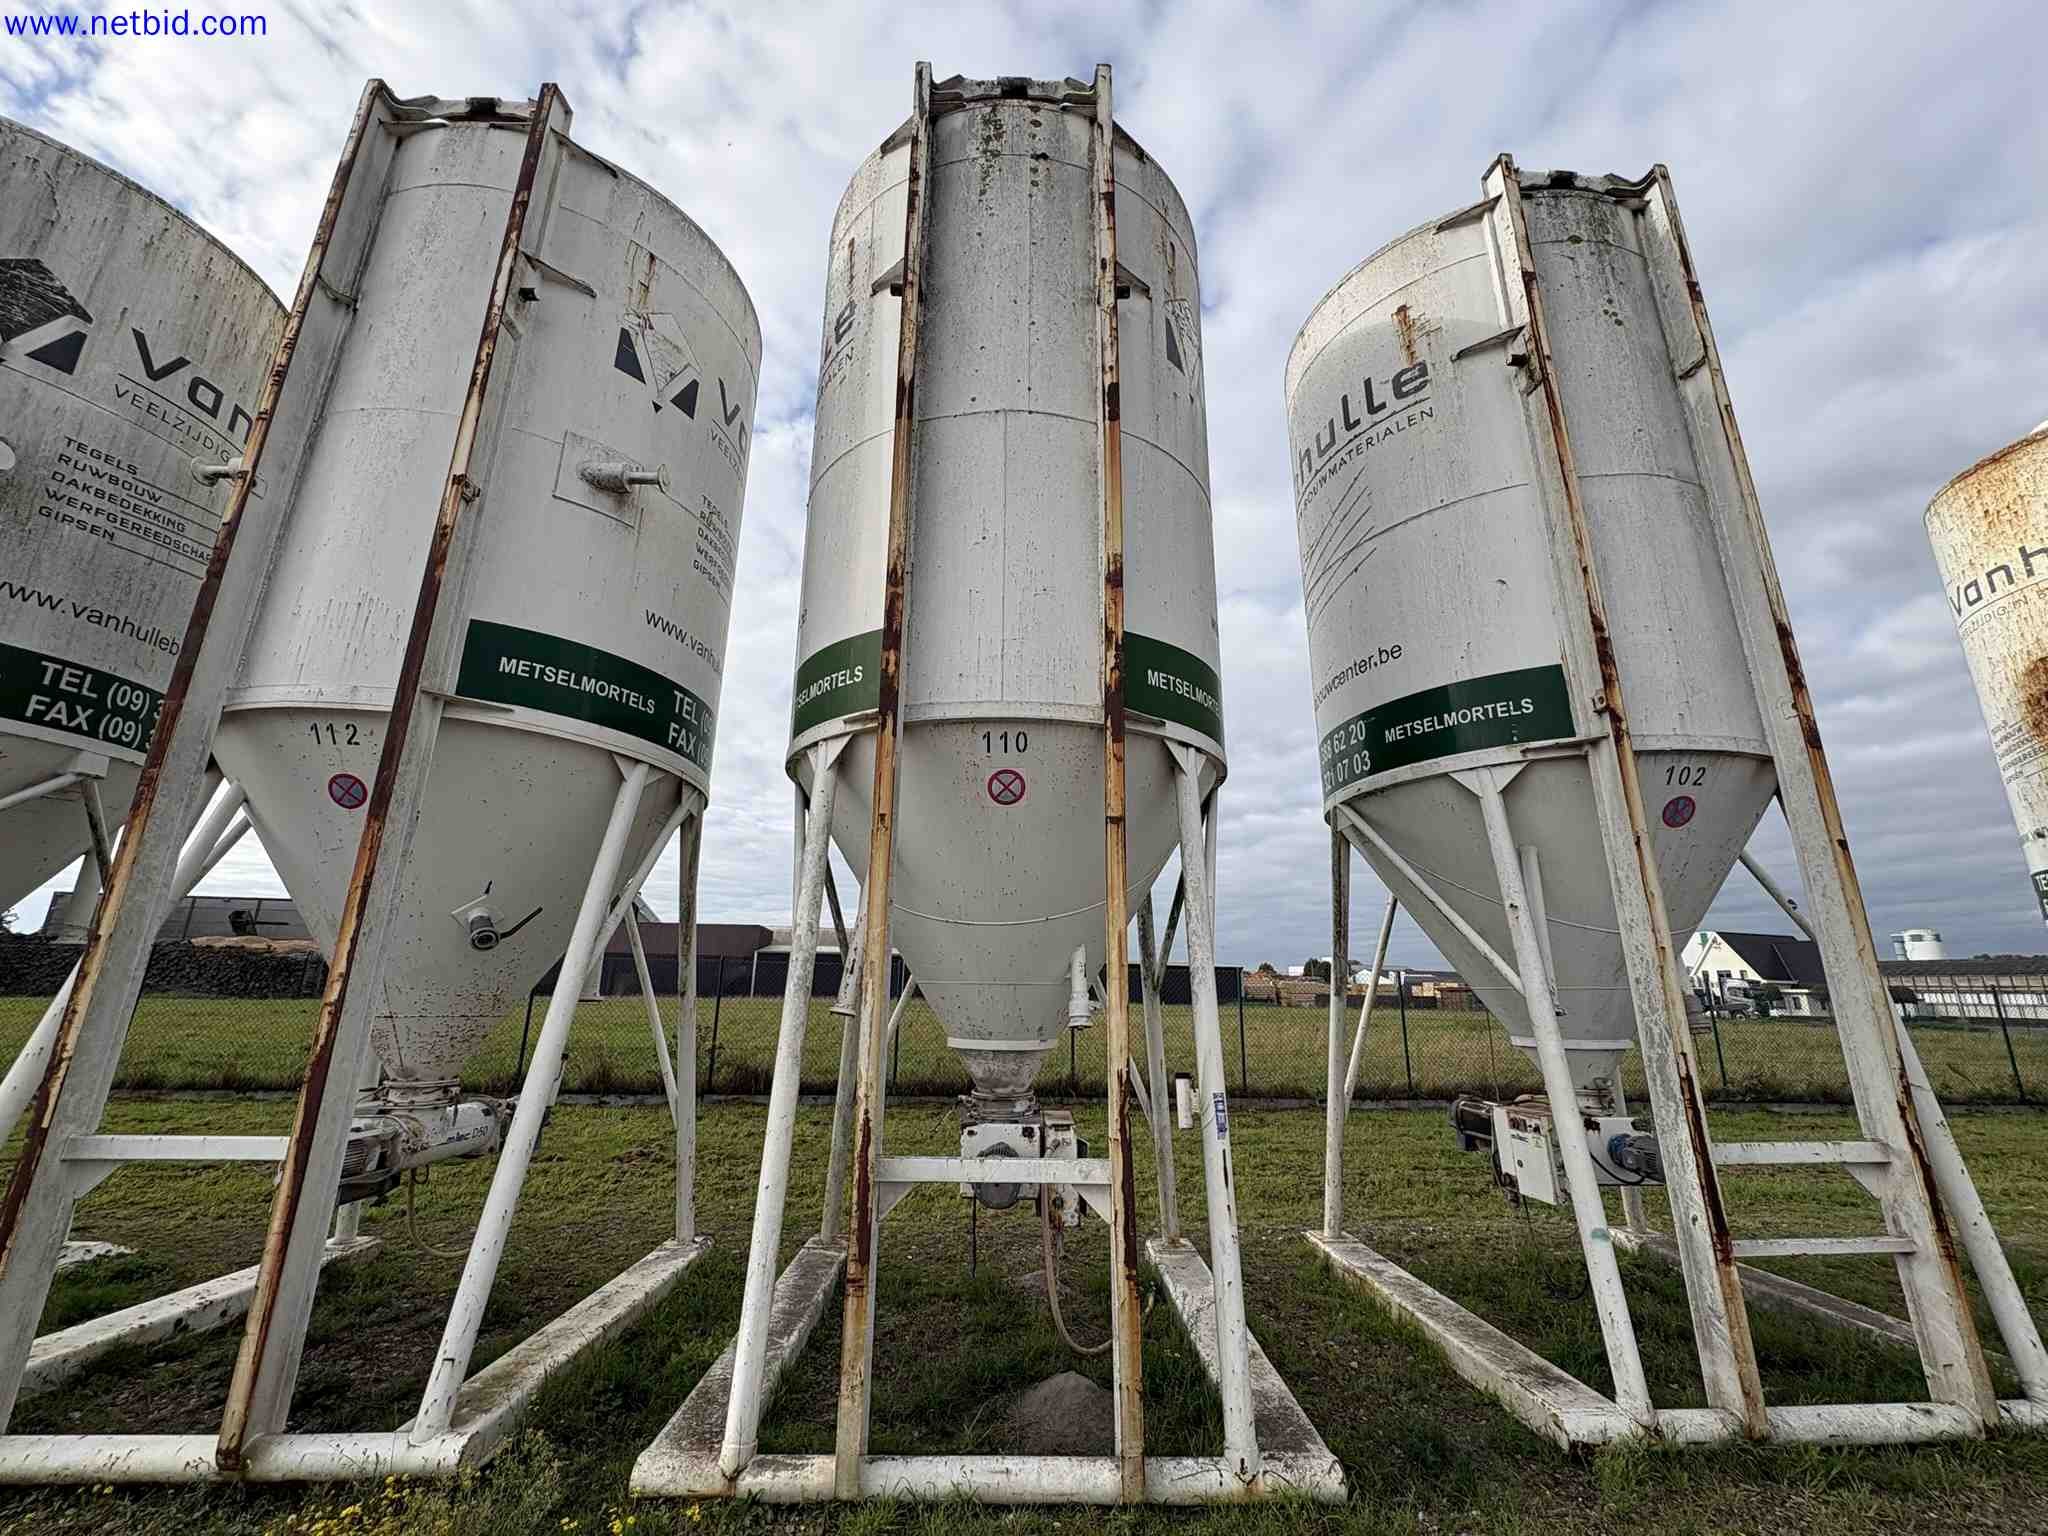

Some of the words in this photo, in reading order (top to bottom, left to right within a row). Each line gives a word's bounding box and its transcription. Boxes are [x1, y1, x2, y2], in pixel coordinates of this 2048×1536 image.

[64, 436, 139, 475] TEGELS
[57, 453, 162, 503] RUWBOUW
[51, 471, 187, 533] DAKBEDEKKING
[38, 505, 116, 541] GIPSEN
[40, 660, 98, 698] TEL
[107, 682, 150, 718] (09)
[498, 656, 656, 714] METSELMORTELS
[25, 694, 95, 731] FAX
[98, 713, 142, 749] (09)
[674, 690, 698, 725] TEL
[1385, 698, 1534, 743] METSELMORTELS
[311, 722, 360, 745] 112
[668, 721, 697, 758] FAX
[982, 730, 1028, 753] 110
[1349, 720, 1366, 745] 20
[1353, 750, 1371, 774] 03
[1666, 765, 1706, 786] 102
